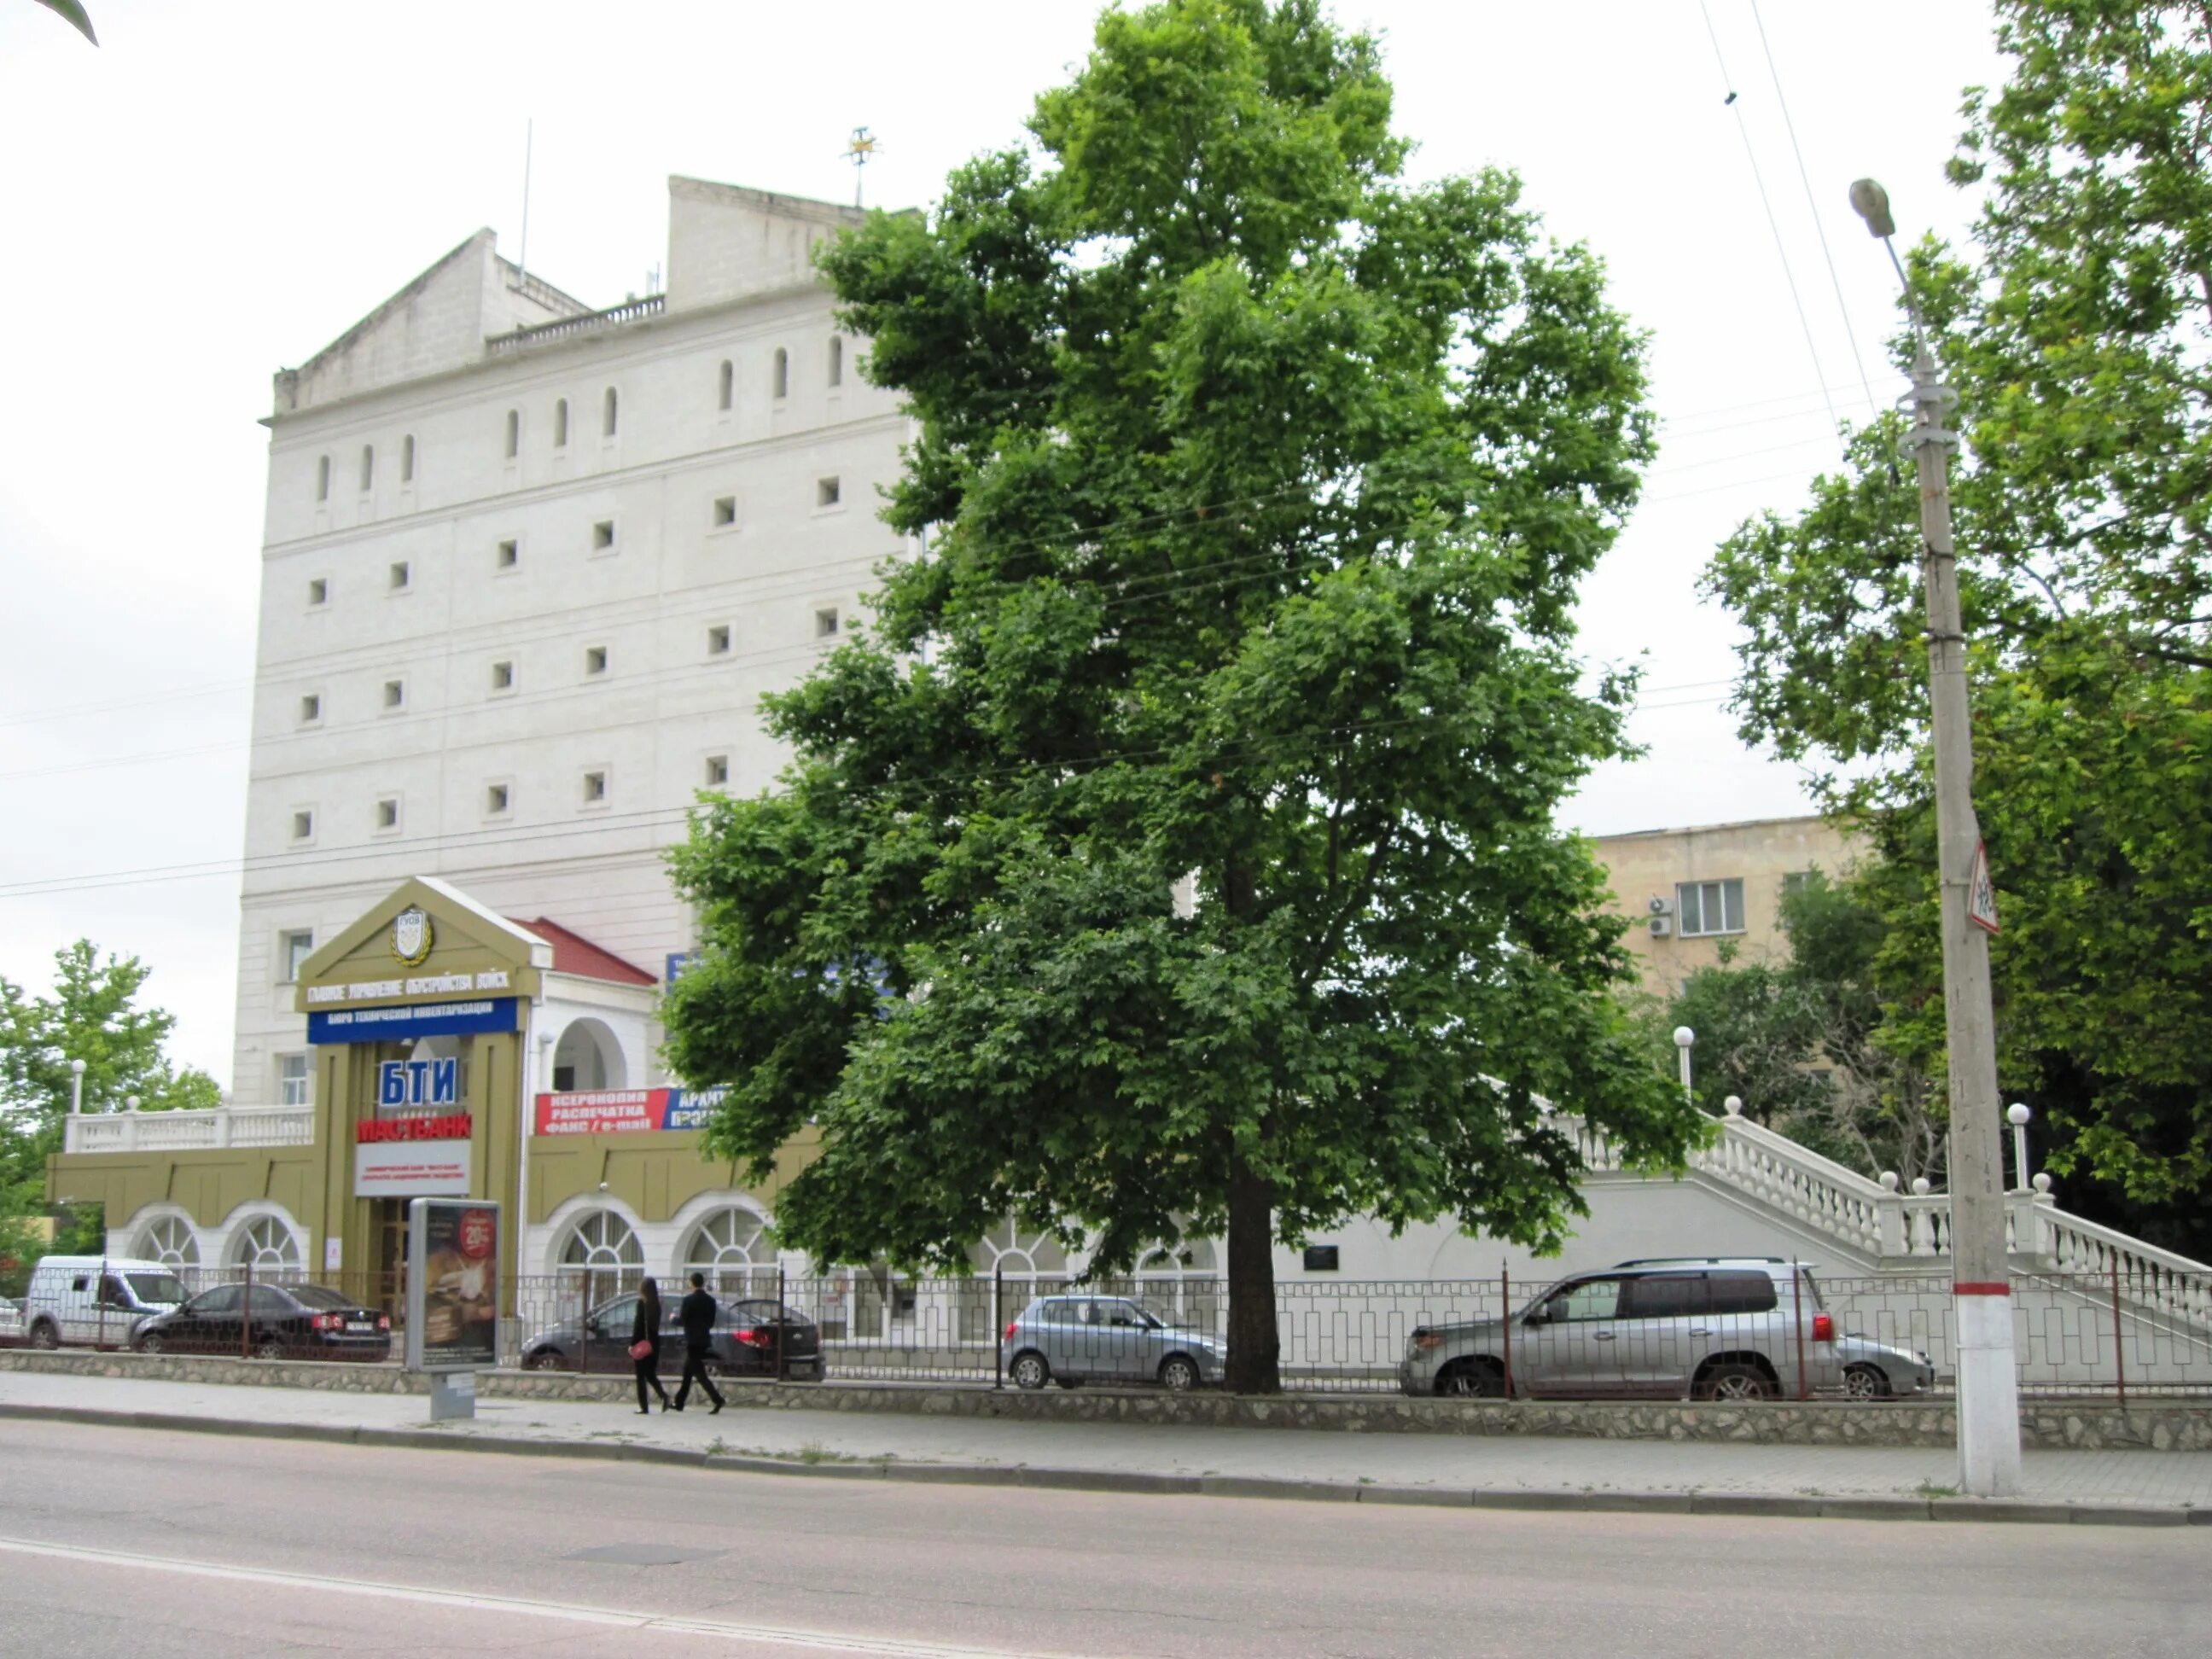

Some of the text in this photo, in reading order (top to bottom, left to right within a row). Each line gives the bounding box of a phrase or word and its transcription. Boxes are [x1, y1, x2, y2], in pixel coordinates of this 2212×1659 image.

[399, 915, 420, 926] ГУОВ
[308, 985, 345, 1003] ГЛАВНОЕ
[348, 980, 403, 999] УПРАВЛЕНИЕ
[328, 1002, 493, 1025] БЮРО ТЕХНИЧЕСКОЙ ИНВЕНТАРИЗАЦИИ
[380, 1057, 457, 1106] БТИ
[550, 1092, 647, 1107] КСЕРОКОПИЯ
[551, 1106, 645, 1120] РАСПЕЧАТКА
[545, 1121, 589, 1133] ФАКС
[602, 1118, 651, 1131] e-mail
